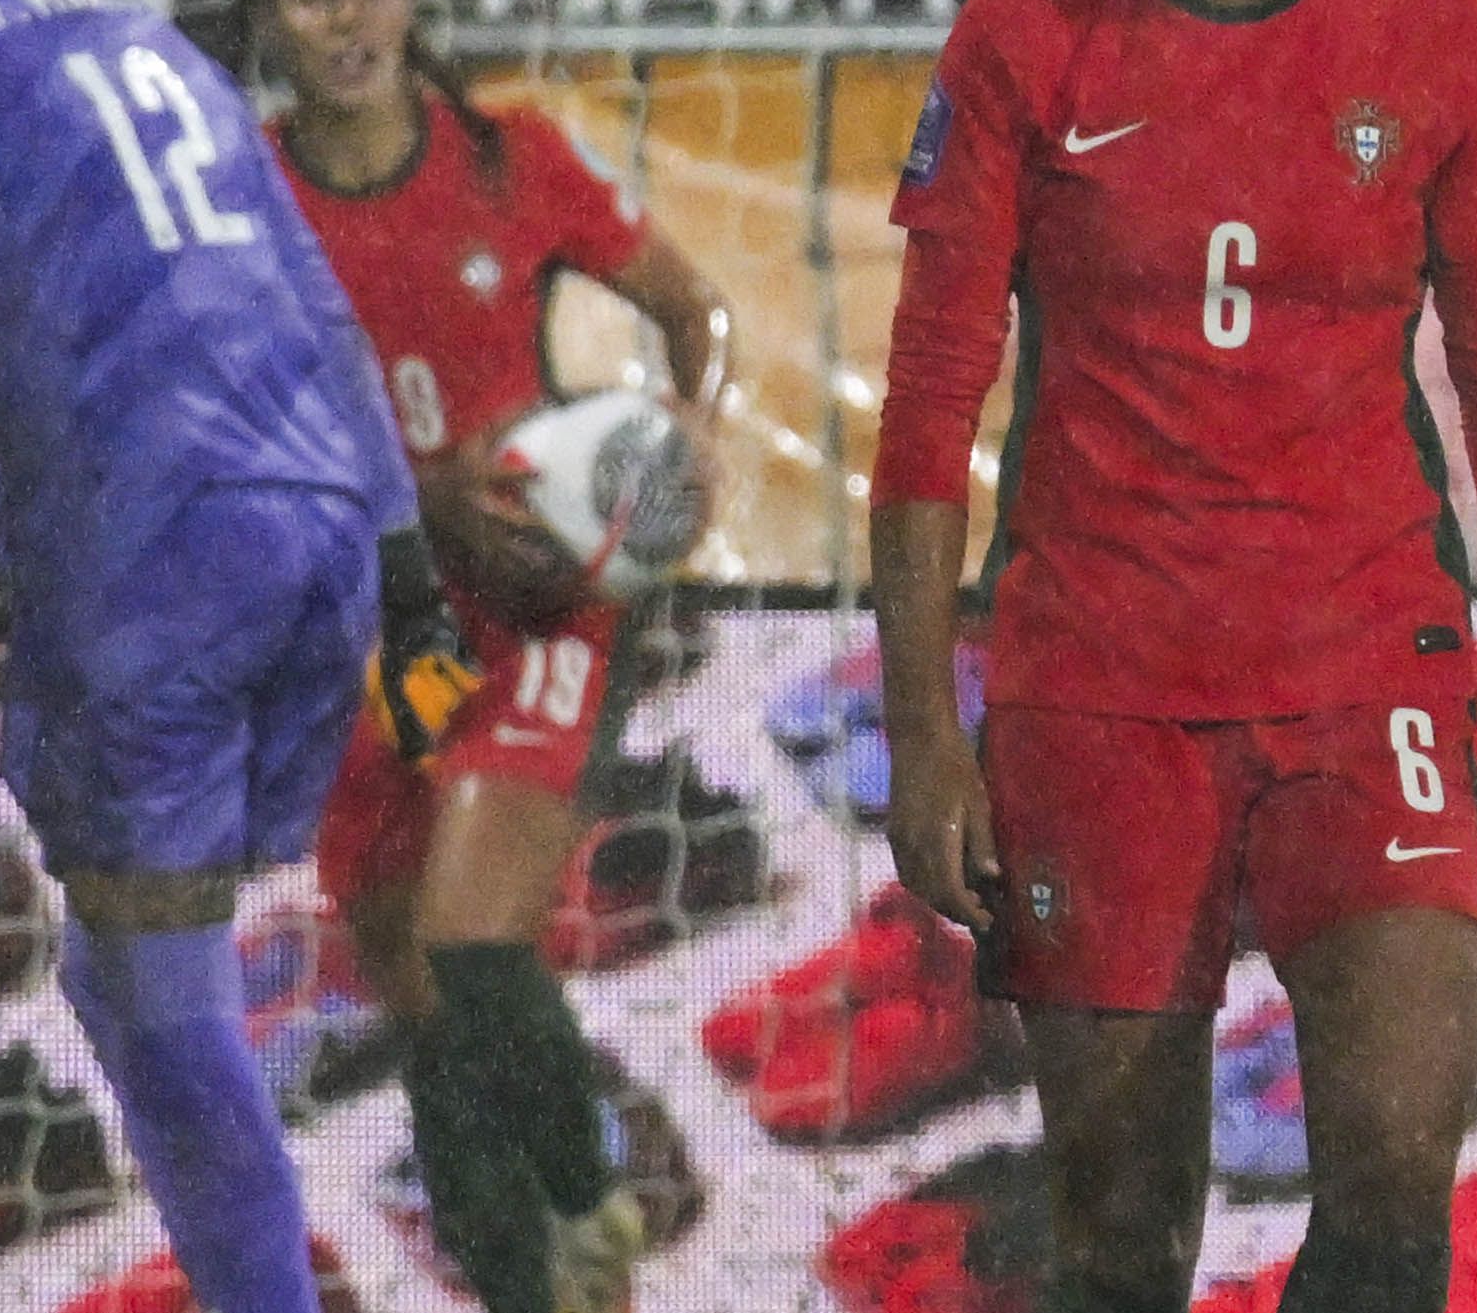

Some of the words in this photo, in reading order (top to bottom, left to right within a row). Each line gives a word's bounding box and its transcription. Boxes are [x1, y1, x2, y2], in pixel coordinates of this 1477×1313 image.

[64, 46, 258, 252] 12
[1203, 222, 1257, 349] 6
[1389, 707, 1445, 813] 6
